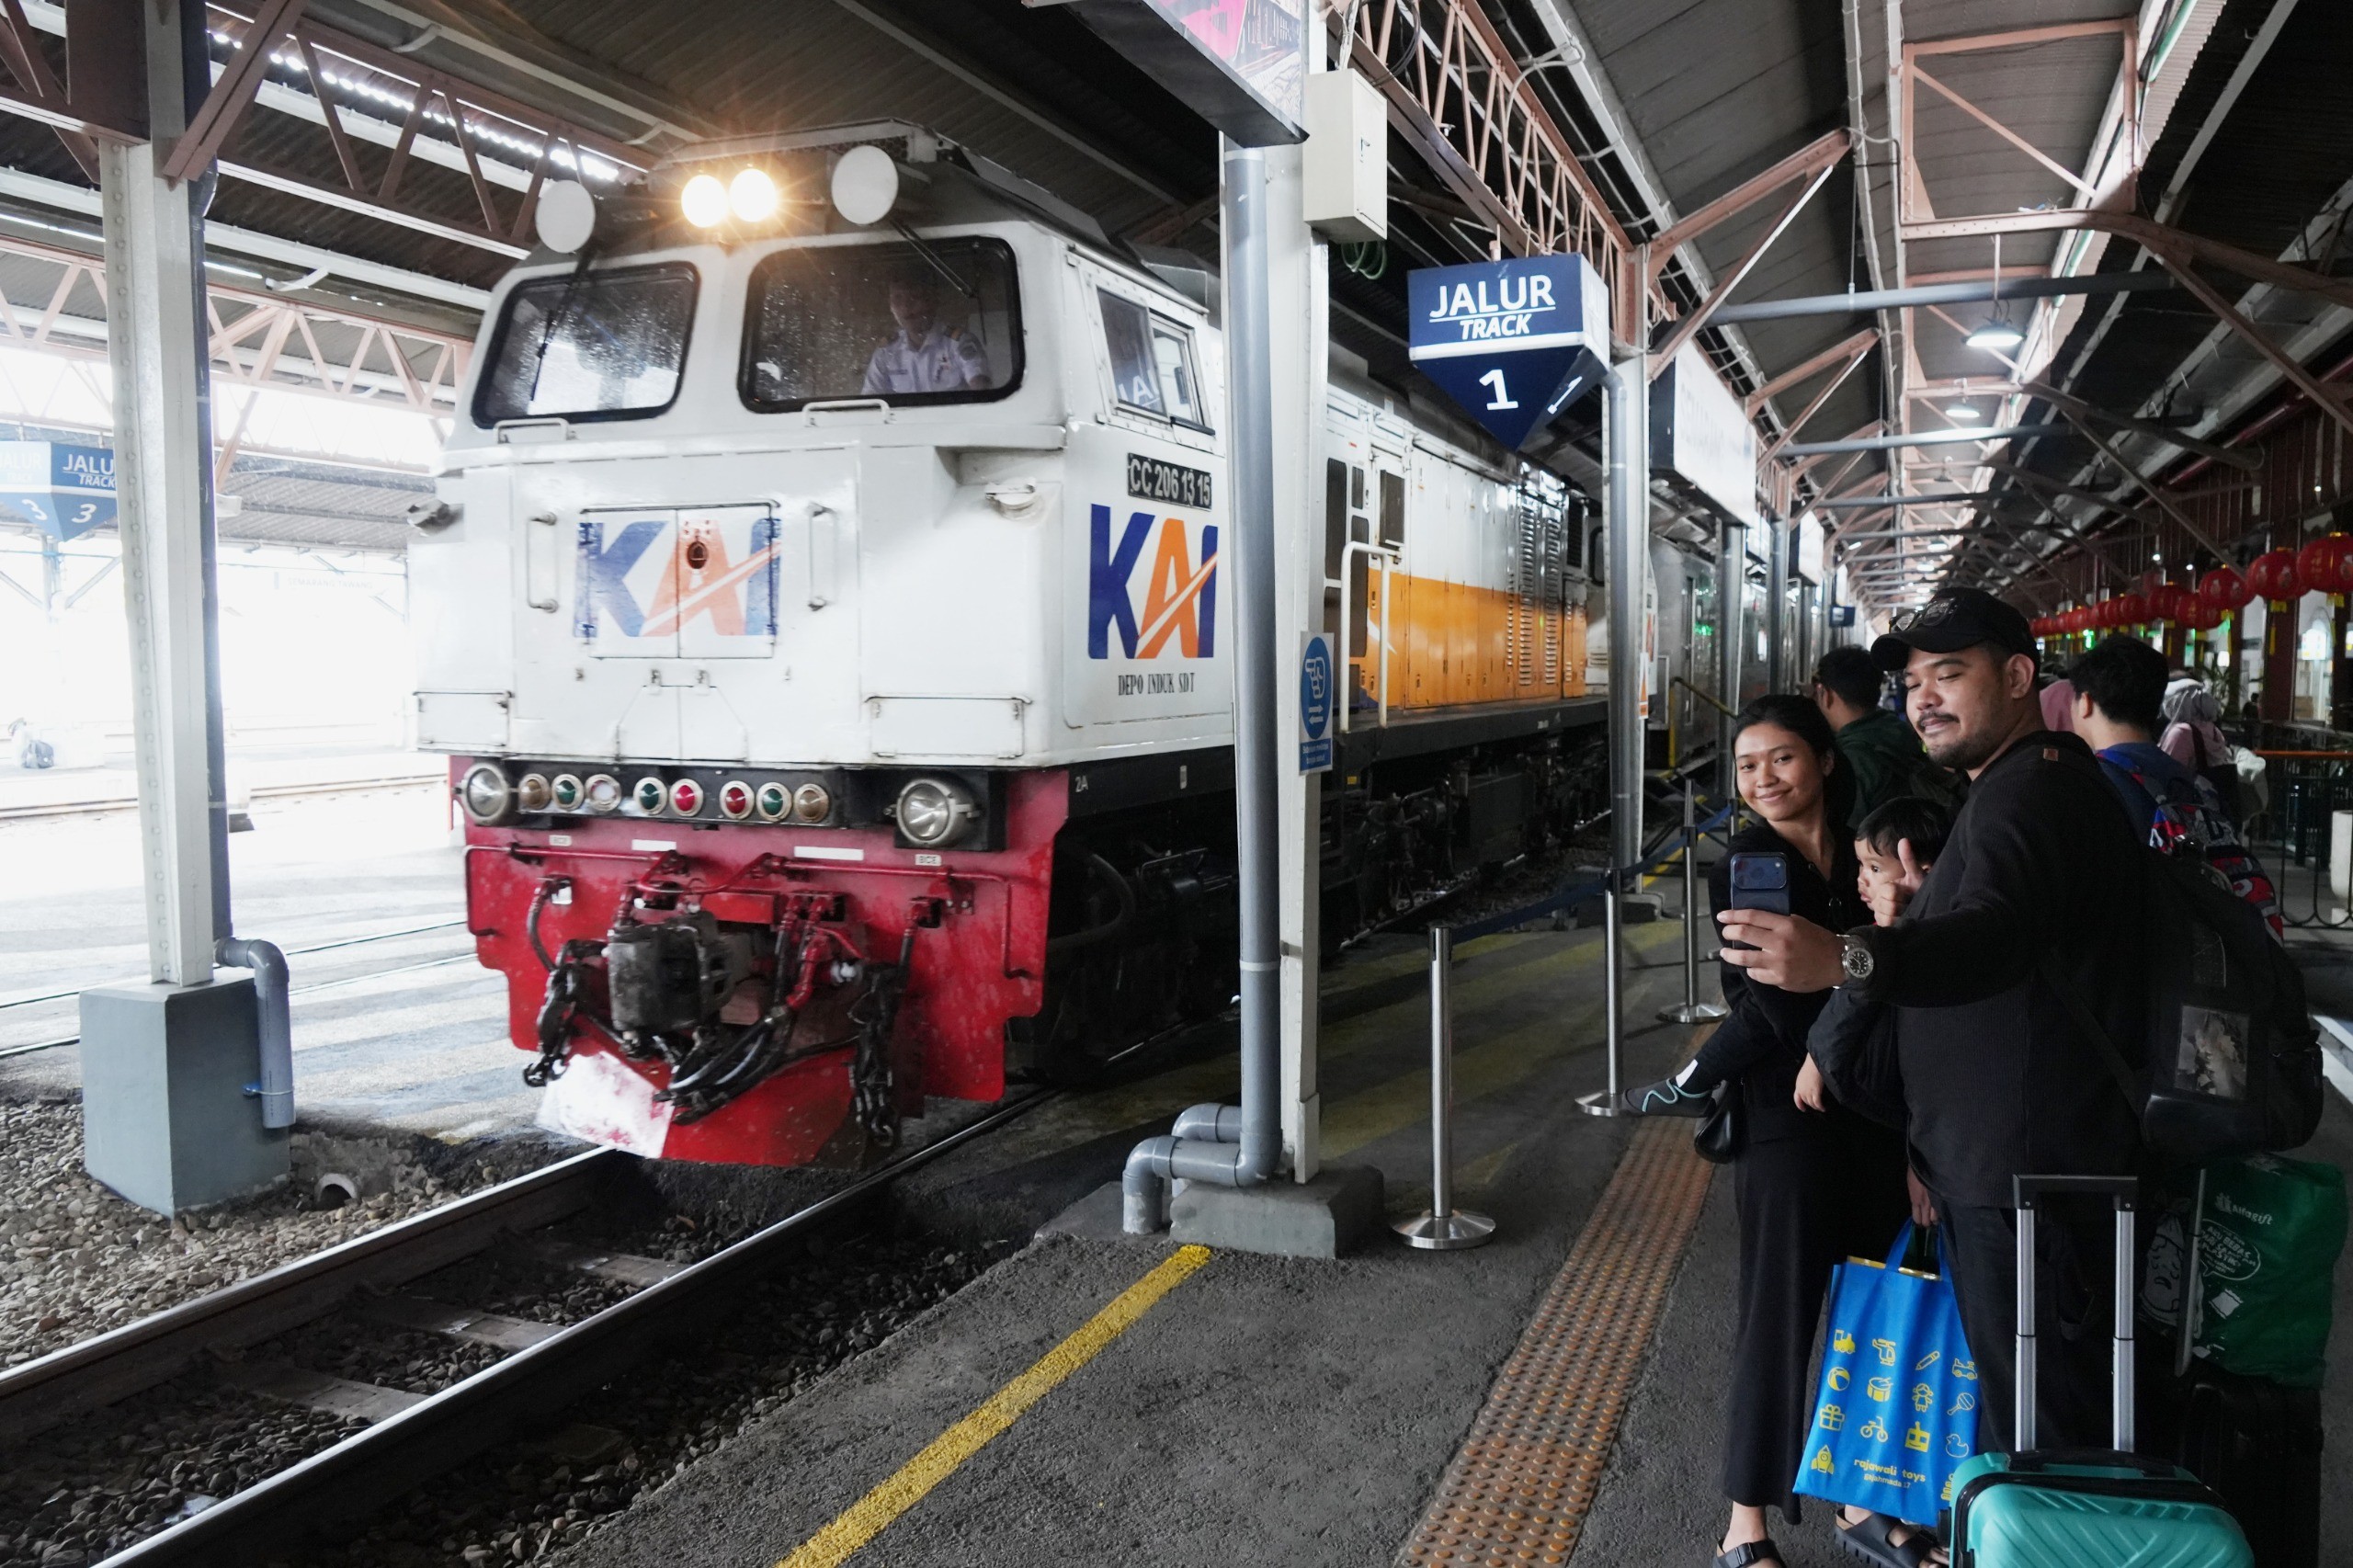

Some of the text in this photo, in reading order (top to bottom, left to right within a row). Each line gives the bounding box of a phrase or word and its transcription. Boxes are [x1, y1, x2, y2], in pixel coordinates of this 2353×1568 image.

[1429, 275, 1555, 318] JALUR
[1460, 313, 1532, 340] TRACK
[1479, 369, 1518, 410] 1
[63, 454, 114, 475] JALU
[1130, 459, 1211, 506] CC 206 13 15
[22, 499, 48, 521] 3
[71, 504, 97, 523] 3
[573, 519, 781, 637] KAI
[1088, 503, 1218, 659] KAI
[1118, 672, 1195, 696] DEPO INDUK SDT
[1074, 775, 1089, 793] 2A
[1853, 1459, 1927, 1483] rajawali toys
